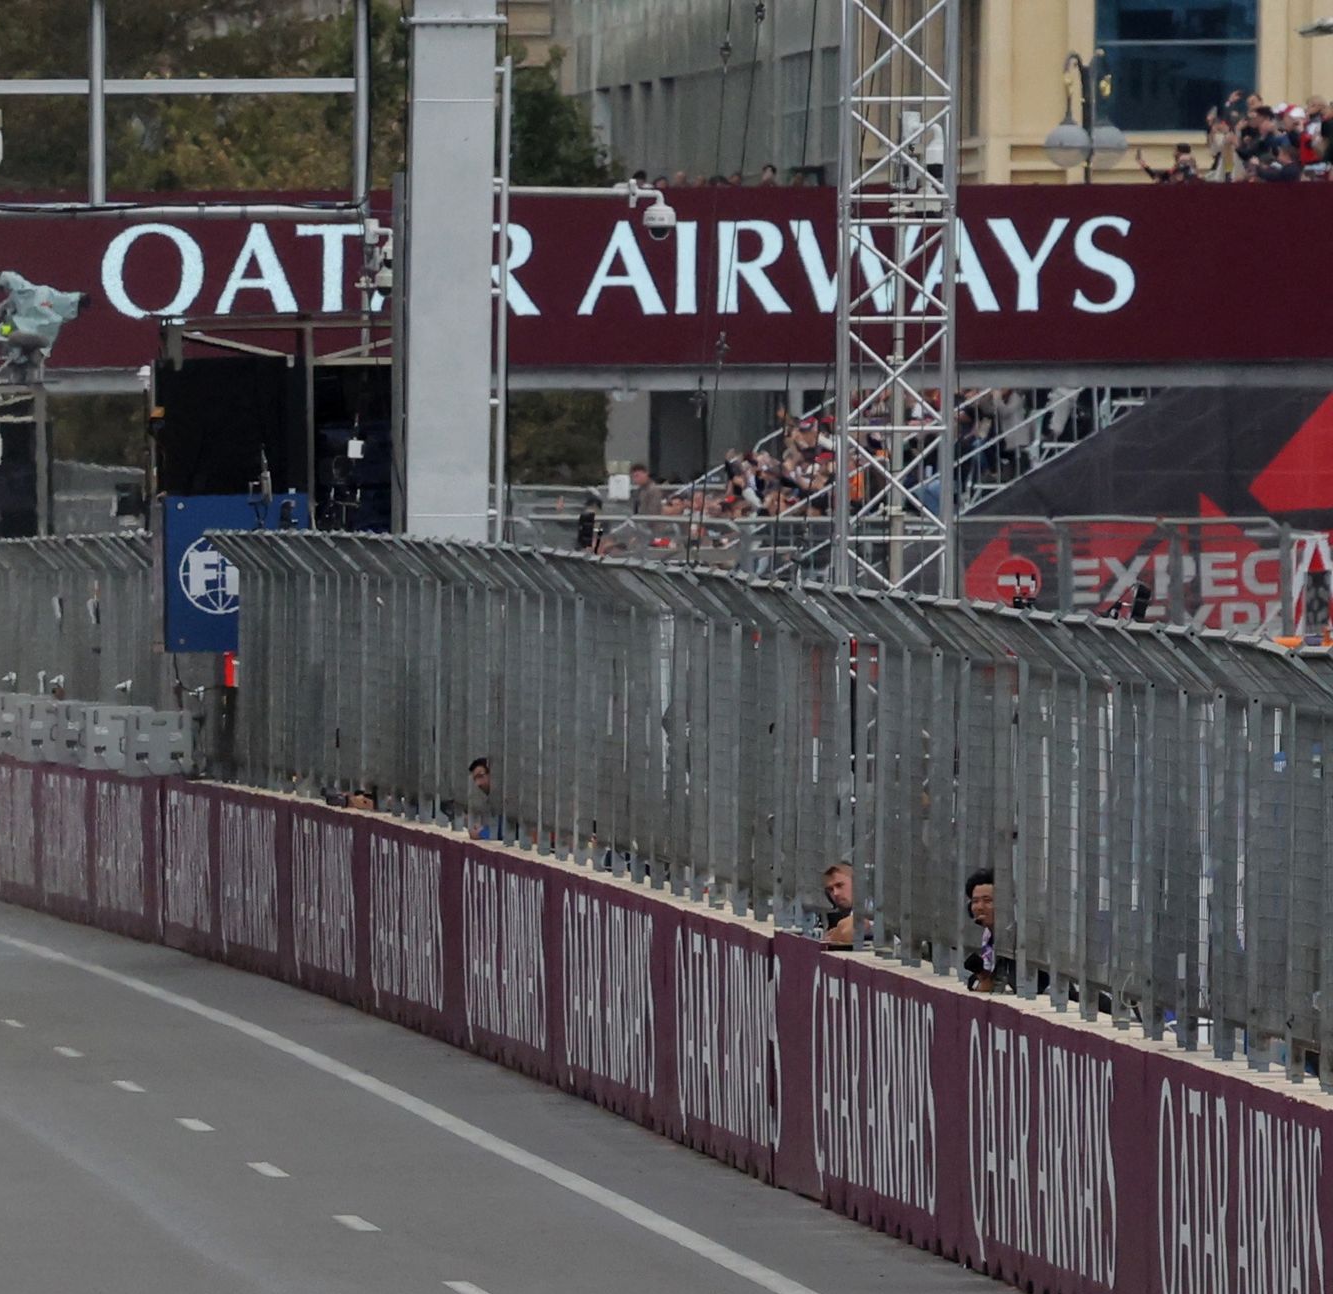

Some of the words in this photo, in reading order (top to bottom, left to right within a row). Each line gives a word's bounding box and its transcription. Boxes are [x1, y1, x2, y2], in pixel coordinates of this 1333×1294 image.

[101, 220, 541, 326] QATR
[576, 215, 1137, 316] AIRWAYS
[812, 964, 864, 1192] QATAR
[866, 985, 936, 1217] AIRWAYS
[968, 1017, 1034, 1262] QATAR
[1036, 1038, 1117, 1290] AIRWAYS
